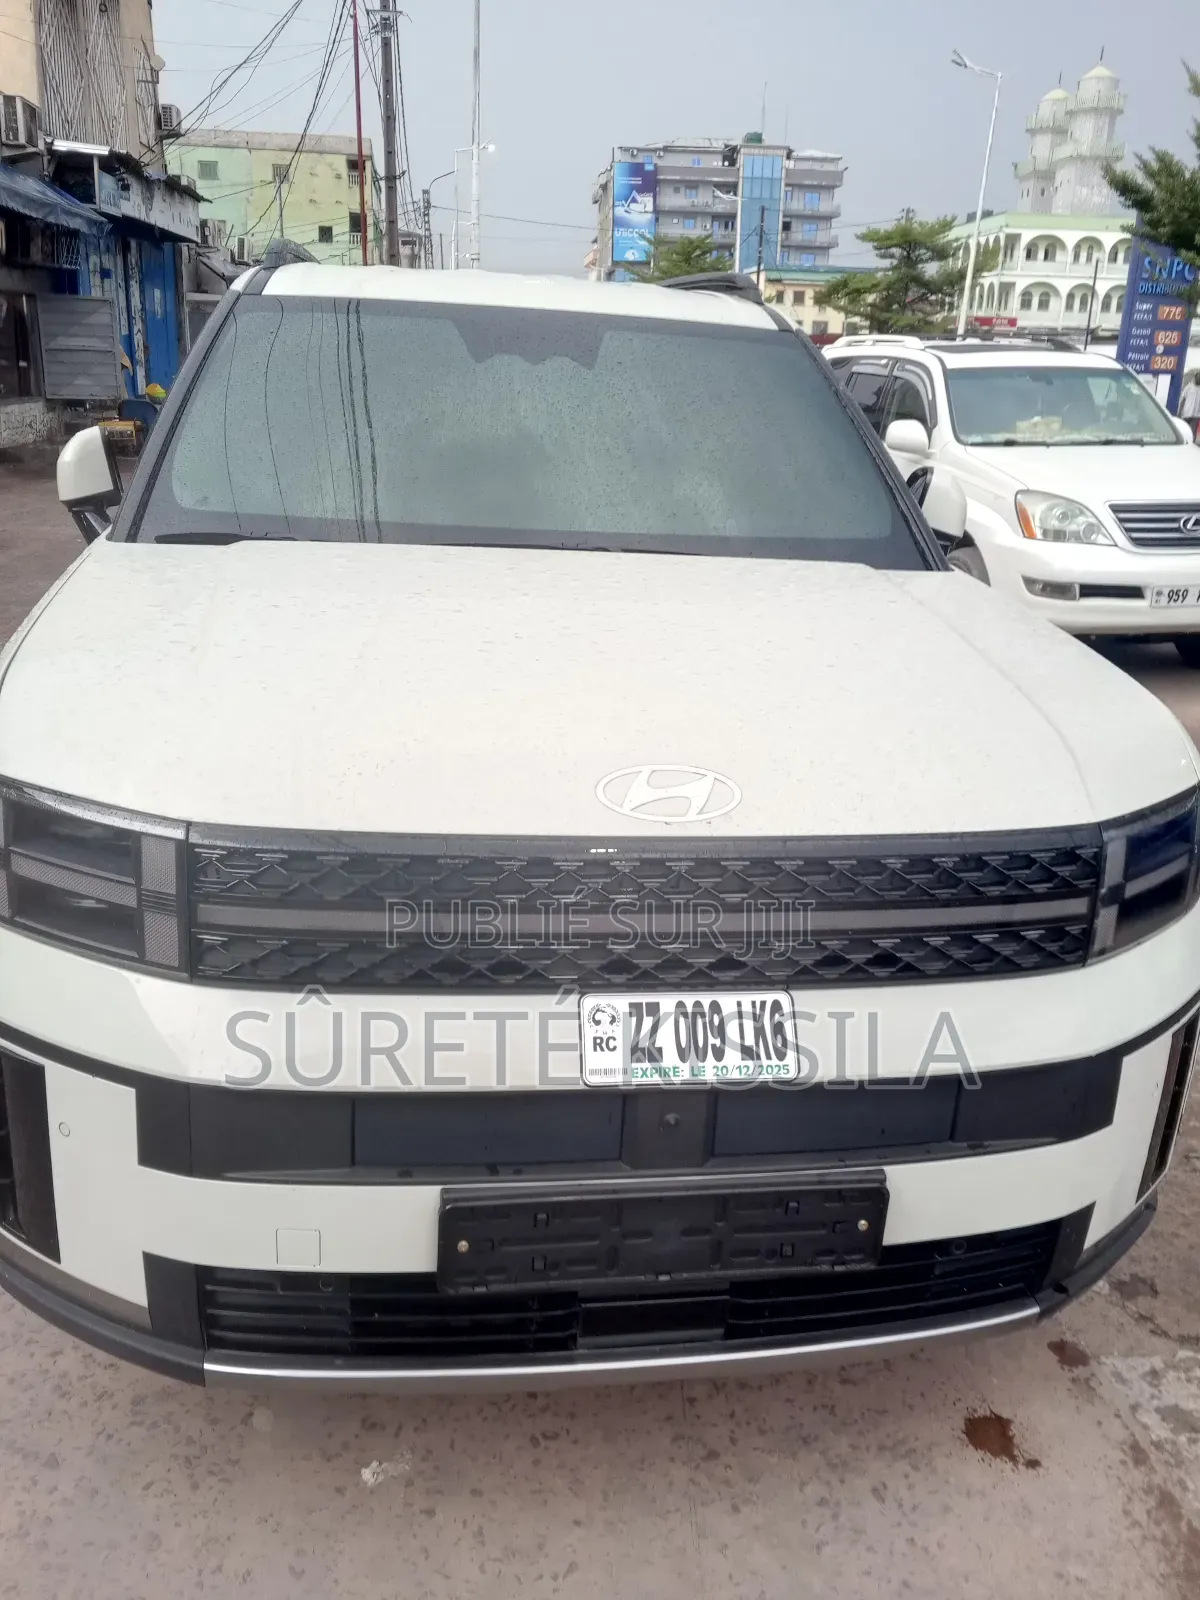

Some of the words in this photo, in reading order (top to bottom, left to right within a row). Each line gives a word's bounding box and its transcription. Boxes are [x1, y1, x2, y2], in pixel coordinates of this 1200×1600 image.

[1141, 256, 1195, 281] SNPC
[1139, 281, 1184, 294] DISTRIBUT
[1136, 301, 1153, 311] Super
[1153, 356, 1174, 369] 320
[1167, 588, 1189, 605] 959
[628, 1001, 664, 1064] ZZ
[673, 999, 727, 1064] 009
[736, 999, 788, 1063] LK6
[592, 1036, 618, 1052] RC
[690, 1065, 706, 1077] LE
[712, 1064, 790, 1077] 20/12/2025
